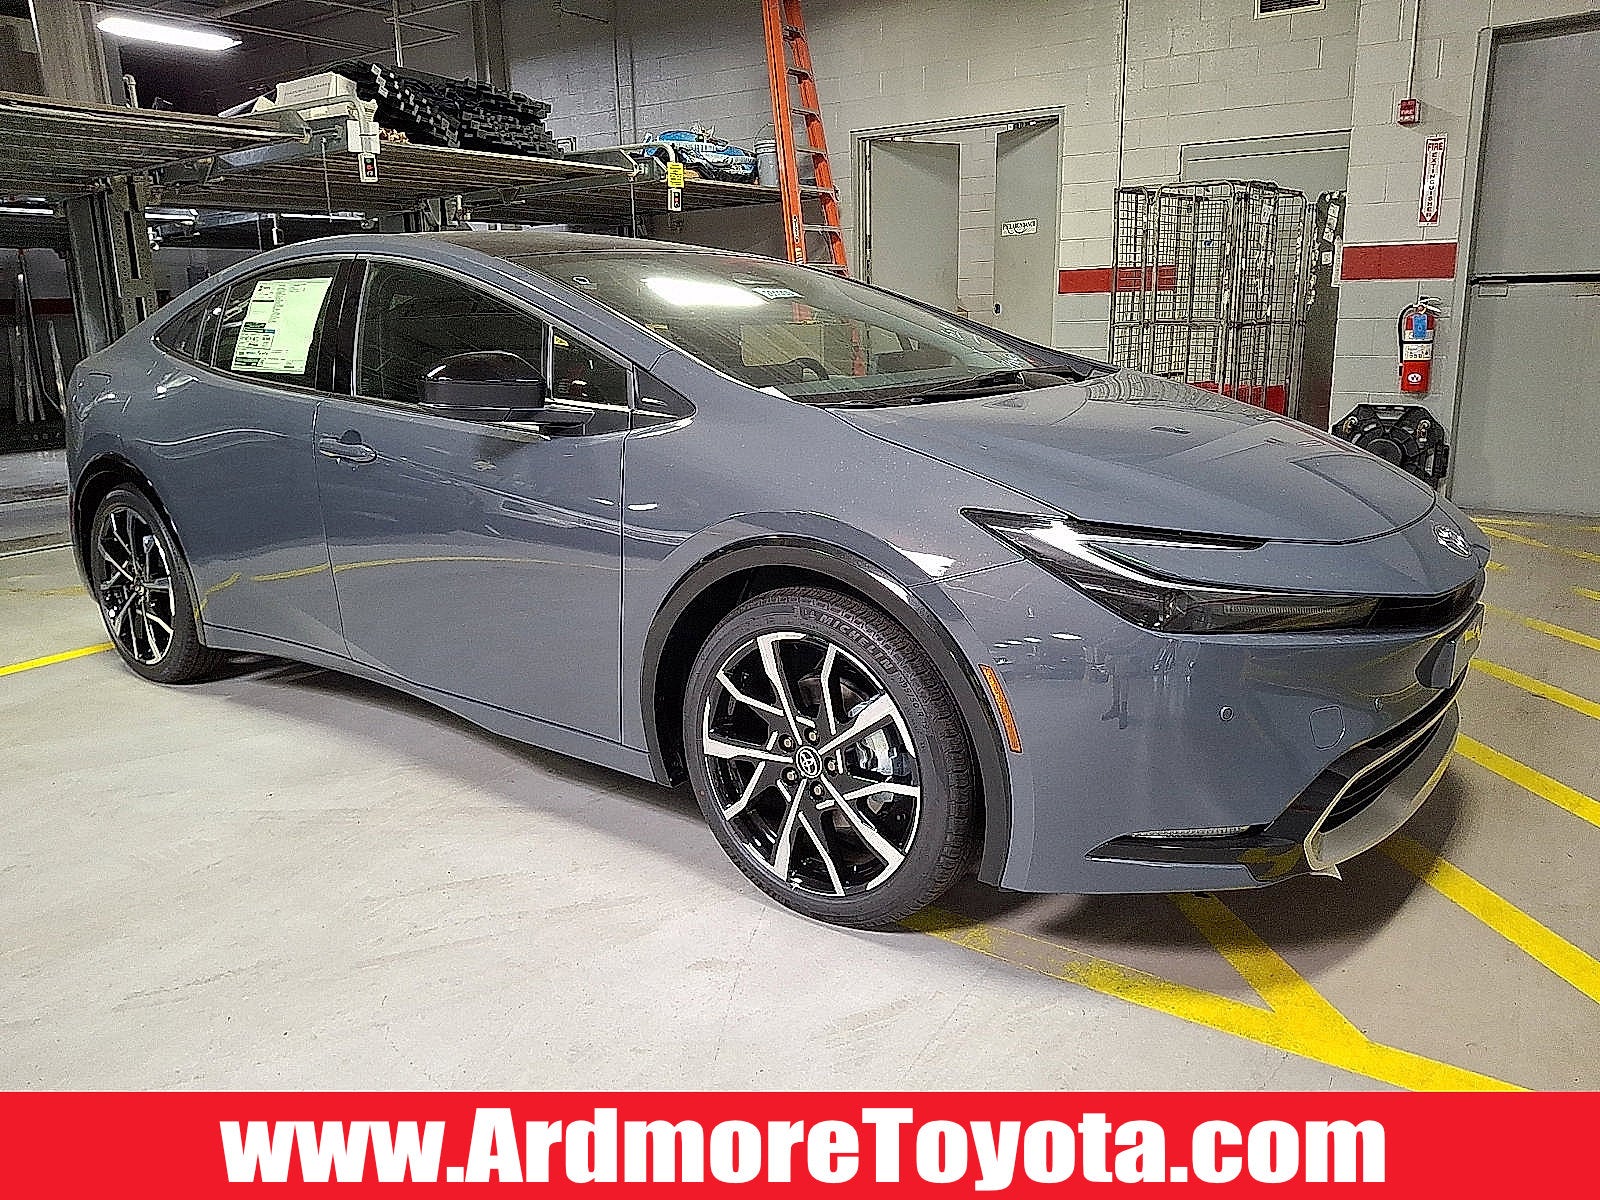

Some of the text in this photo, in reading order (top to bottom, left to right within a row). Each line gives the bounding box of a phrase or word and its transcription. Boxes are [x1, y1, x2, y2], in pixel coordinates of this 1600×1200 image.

[1427, 142, 1444, 151] FIRE
[1425, 151, 1438, 218] EXTINGUISHER
[820, 614, 894, 671] MICHELIN
